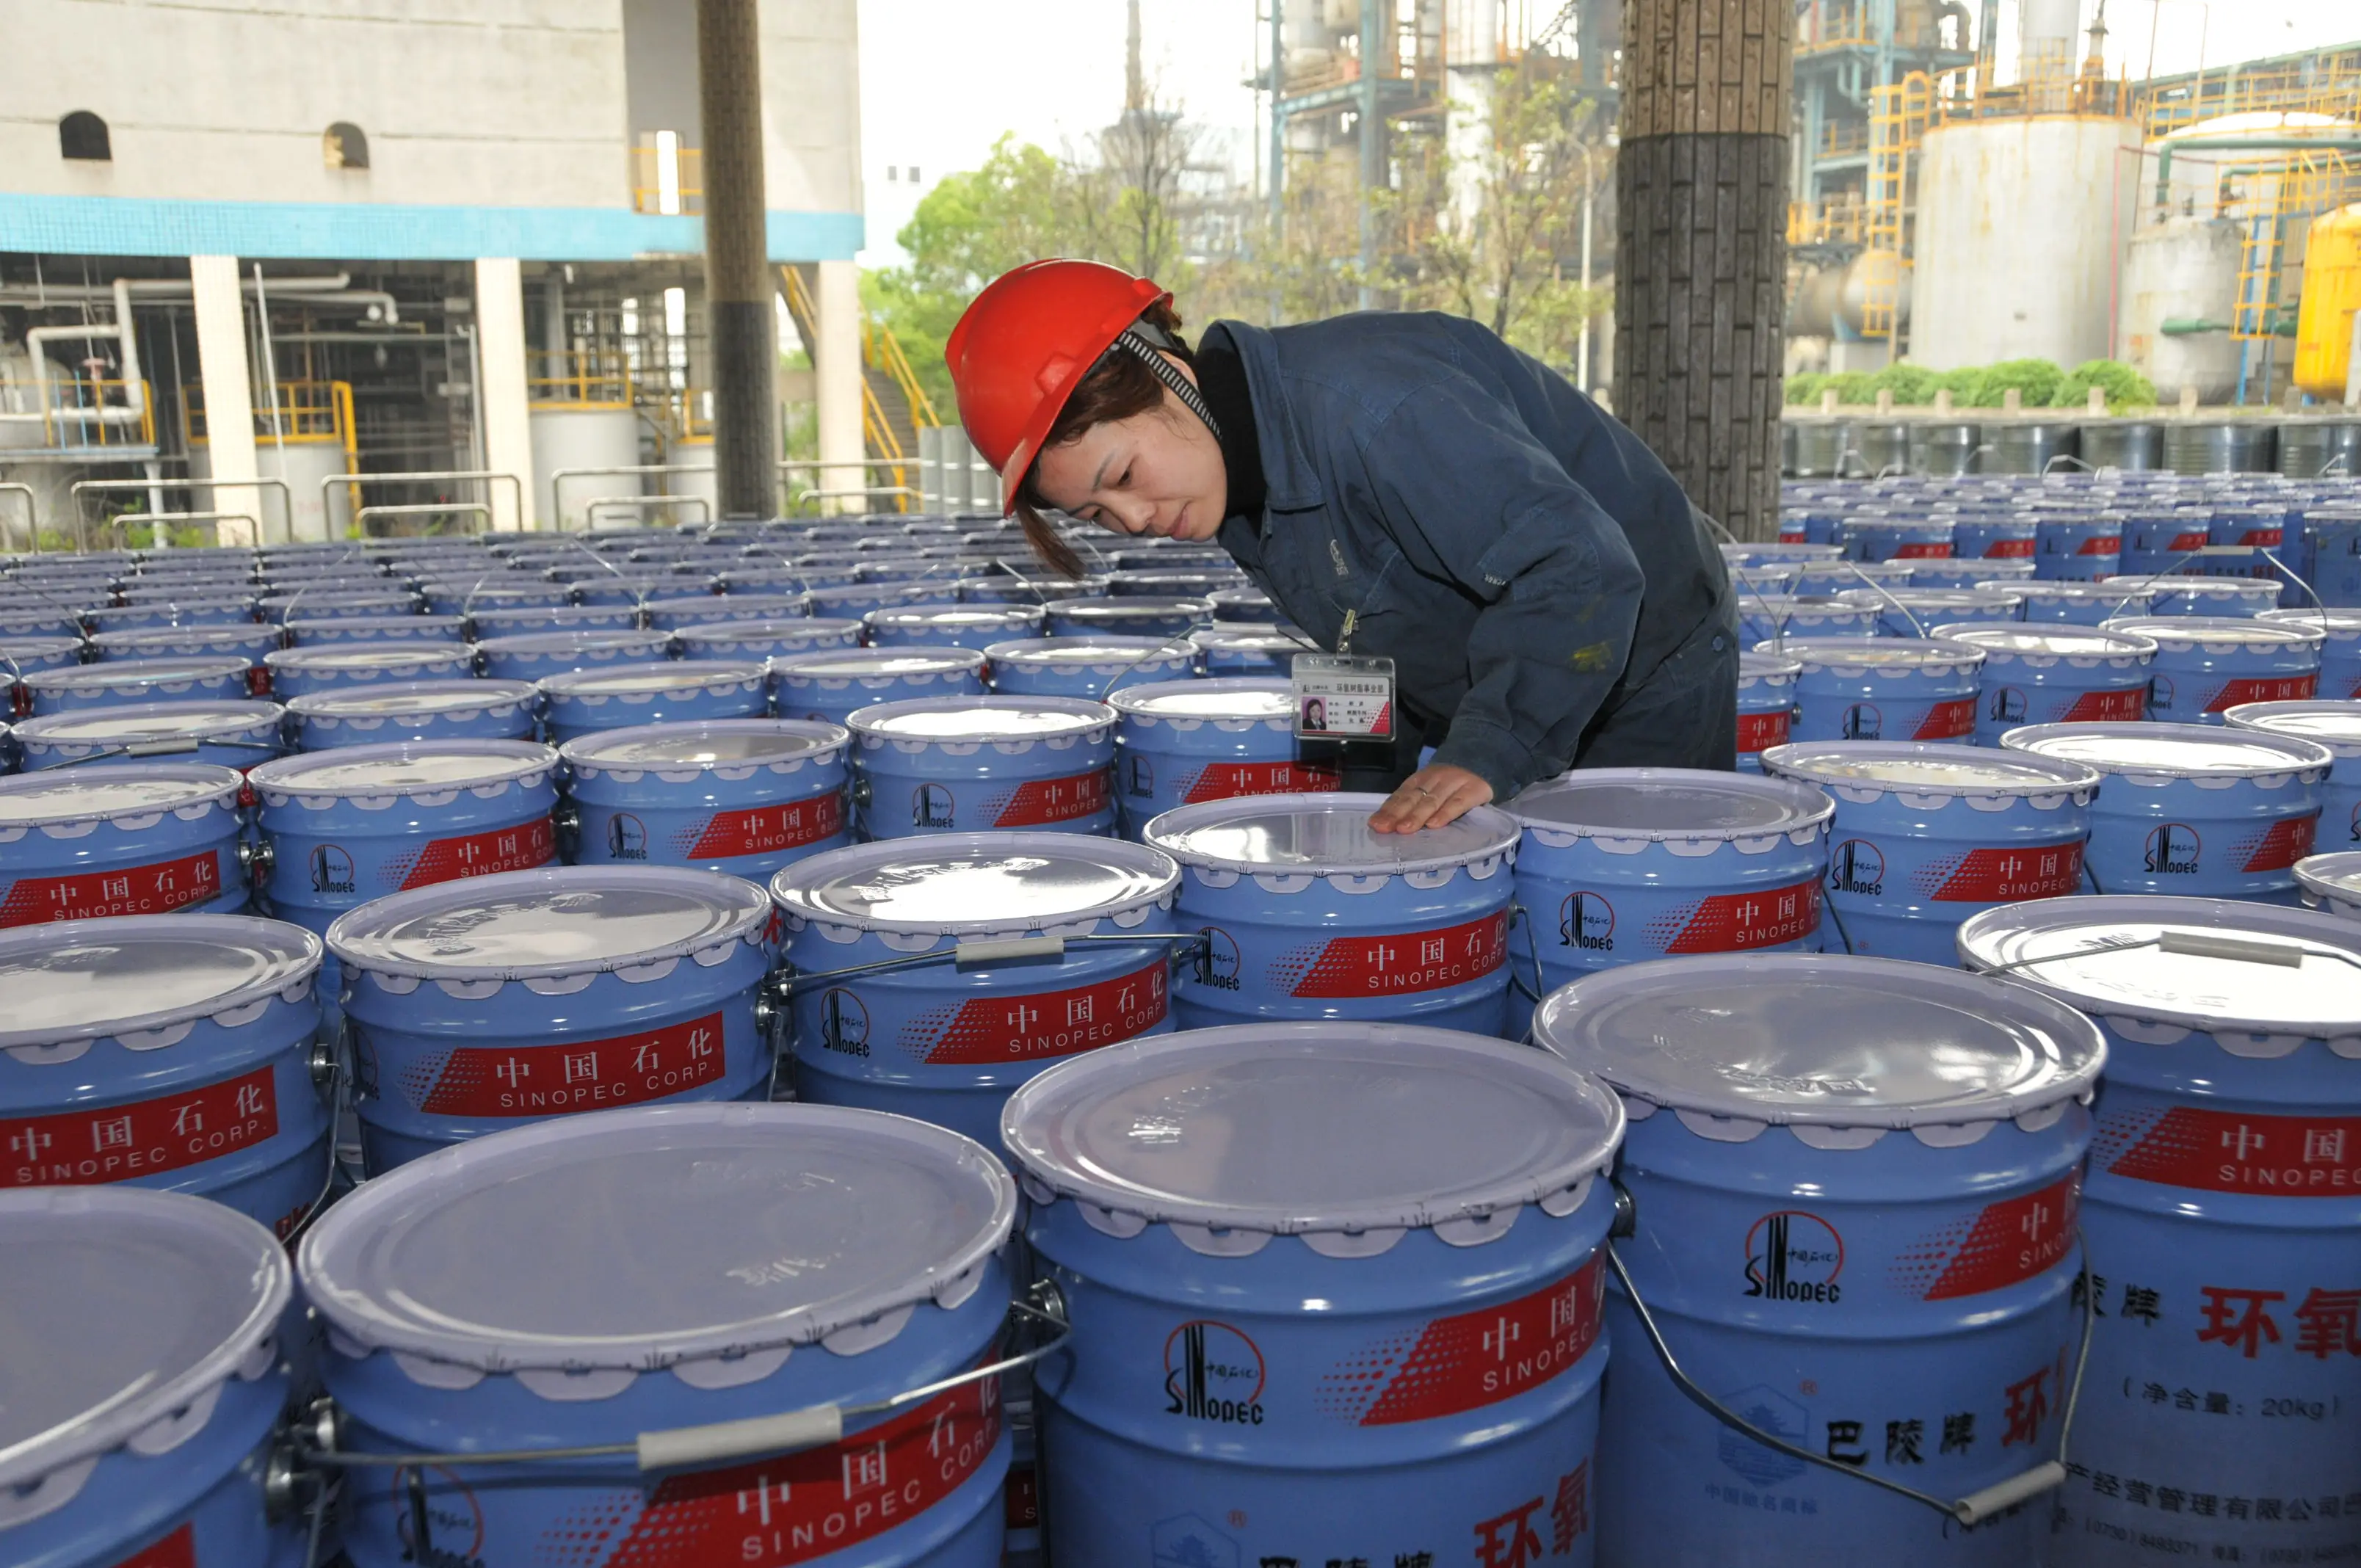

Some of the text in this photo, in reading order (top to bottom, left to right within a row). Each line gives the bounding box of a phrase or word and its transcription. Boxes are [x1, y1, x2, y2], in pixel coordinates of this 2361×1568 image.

[745, 827, 813, 849] SINOPEC
[2144, 824, 2198, 874] SINOPEC
[51, 860, 212, 906] 中国石化
[460, 854, 529, 879] SINOPEC
[1832, 841, 1882, 896] SINOPEC
[1998, 878, 2066, 896] SINOPEC
[54, 898, 150, 921] SINOPEC
[1559, 893, 1614, 951] SINOPEC
[1736, 918, 1805, 943] SINOPEC
[1368, 919, 1505, 971] 中国石化
[1007, 969, 1164, 1034] 中国石化
[1368, 963, 1462, 989] SINOPEC
[822, 990, 870, 1058] SINOPEC
[1009, 1023, 1113, 1053] SINOPEC
[497, 1028, 713, 1088] 中国石化
[501, 1061, 716, 1108] SINOPEC CORP.
[11, 1084, 264, 1161] 中国石化
[17, 1119, 268, 1183] SINOPEC CORP.
[1742, 1215, 1840, 1304] SINOPEC
[2196, 1285, 2361, 1360] 环氧
[1164, 1324, 1263, 1425] SINOPEC
[1483, 1321, 1589, 1392] SINOPEC
[738, 1371, 998, 1526] 中国石化
[1827, 1412, 1976, 1467] 巴陵牌
[741, 1479, 921, 1561] SINOPEC
